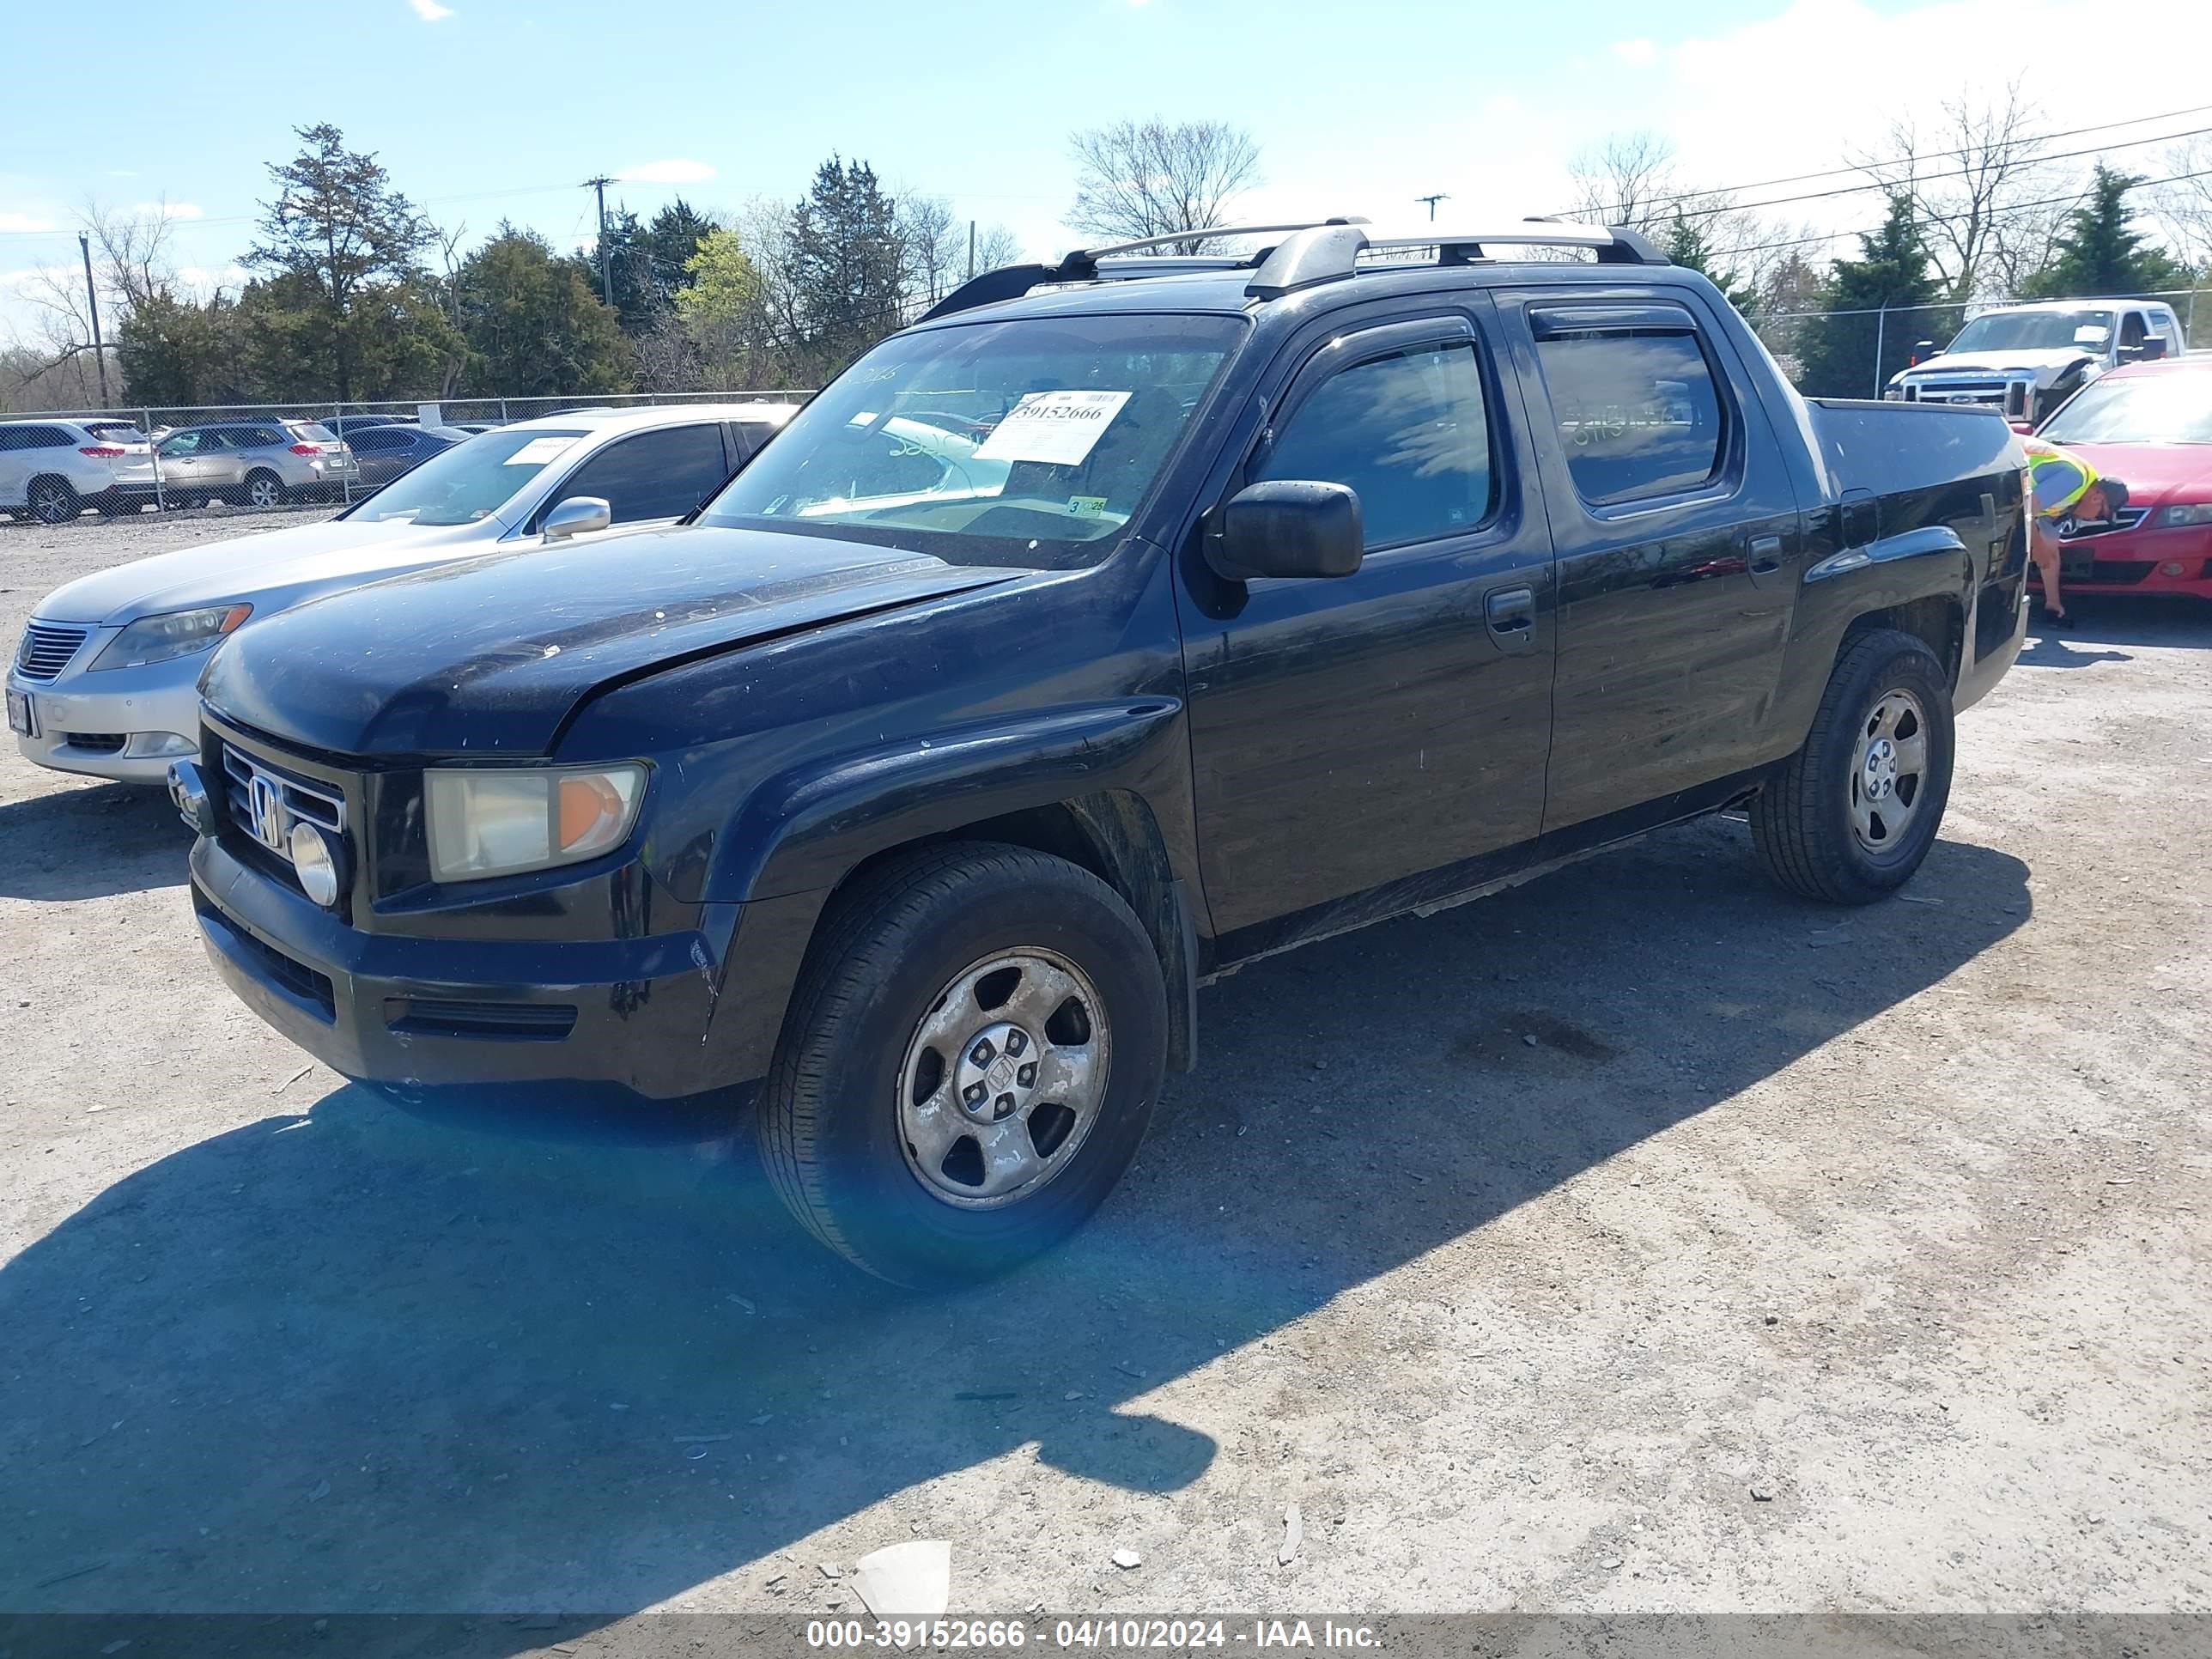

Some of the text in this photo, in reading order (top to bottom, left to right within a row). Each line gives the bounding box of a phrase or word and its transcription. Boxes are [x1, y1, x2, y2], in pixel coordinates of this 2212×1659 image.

[1018, 405, 1107, 420] 39152666
[1069, 501, 1103, 513] 3 25
